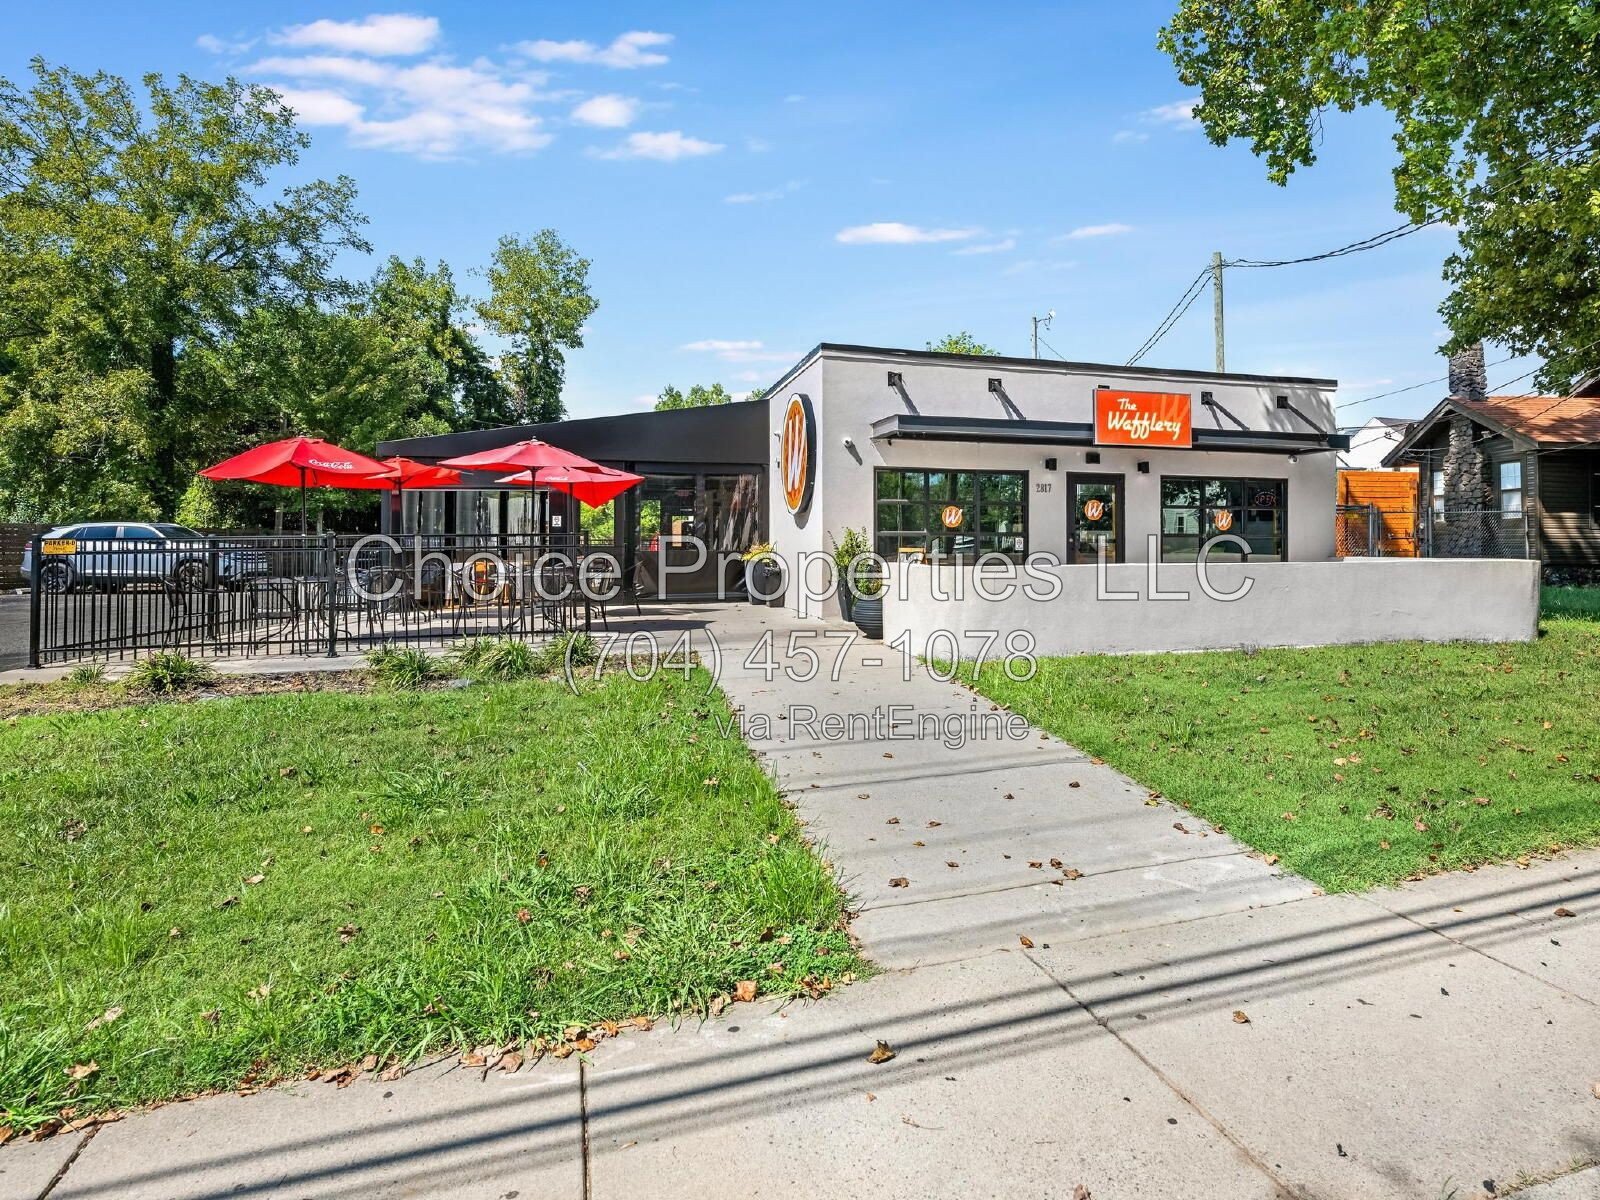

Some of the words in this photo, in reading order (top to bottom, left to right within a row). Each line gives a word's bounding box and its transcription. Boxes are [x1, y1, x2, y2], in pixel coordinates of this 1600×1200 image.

[1117, 398, 1138, 411] The
[1107, 411, 1182, 441] Wafflery
[1035, 483, 1052, 493] 2817
